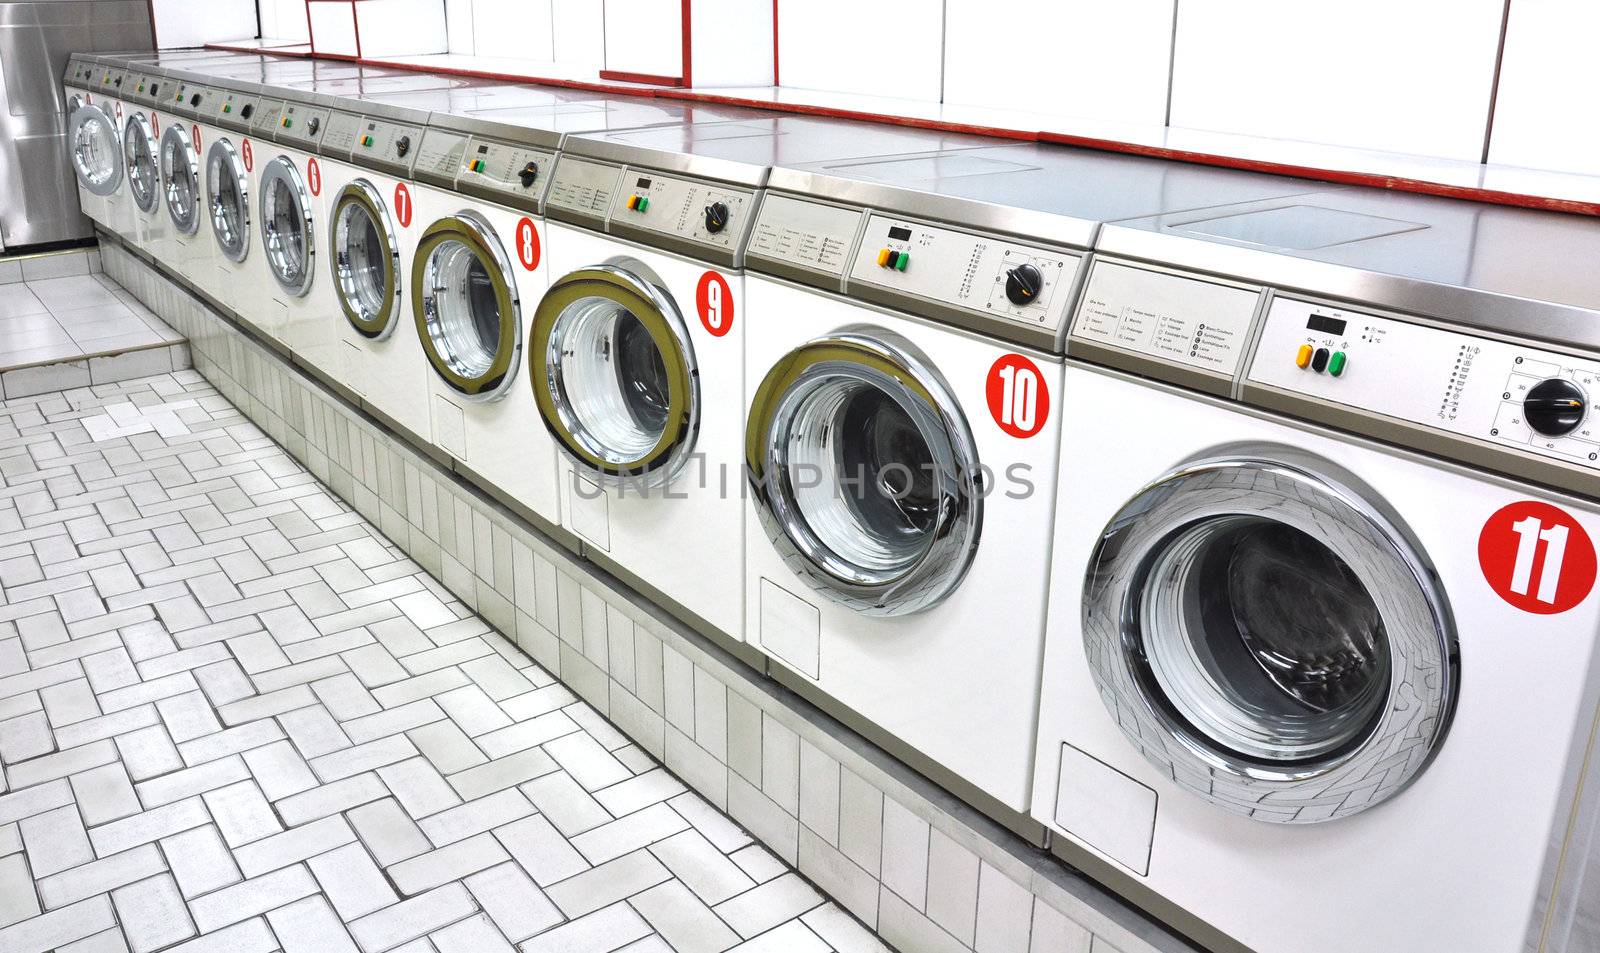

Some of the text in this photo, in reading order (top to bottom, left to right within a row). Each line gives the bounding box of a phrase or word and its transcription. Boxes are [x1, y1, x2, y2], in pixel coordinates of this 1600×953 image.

[310, 162, 318, 192] 6
[399, 190, 406, 223] 7
[522, 224, 533, 265] 8
[707, 280, 722, 329] 9
[999, 364, 1038, 432] 10
[1511, 515, 1570, 605] 11
